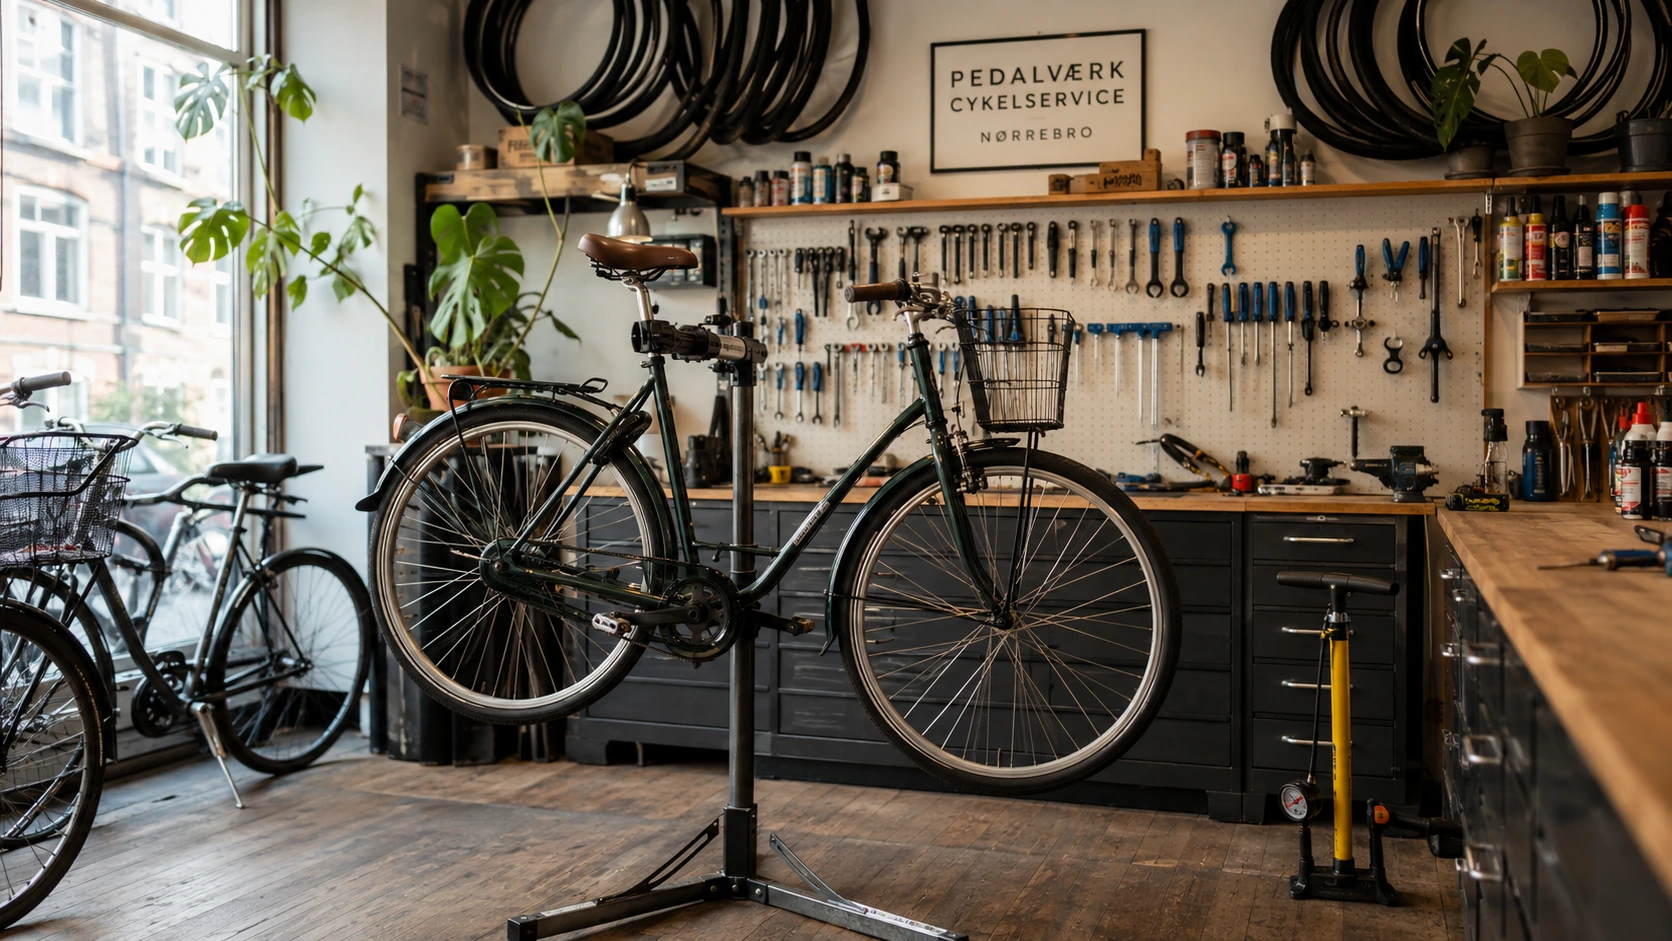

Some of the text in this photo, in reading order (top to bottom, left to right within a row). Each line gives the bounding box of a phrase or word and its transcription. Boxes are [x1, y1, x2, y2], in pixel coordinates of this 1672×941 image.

[951, 60, 1125, 88] PEDALVÆRK
[950, 88, 1125, 112] CYKELSERVICE
[980, 126, 1093, 142] NØRREBRO
